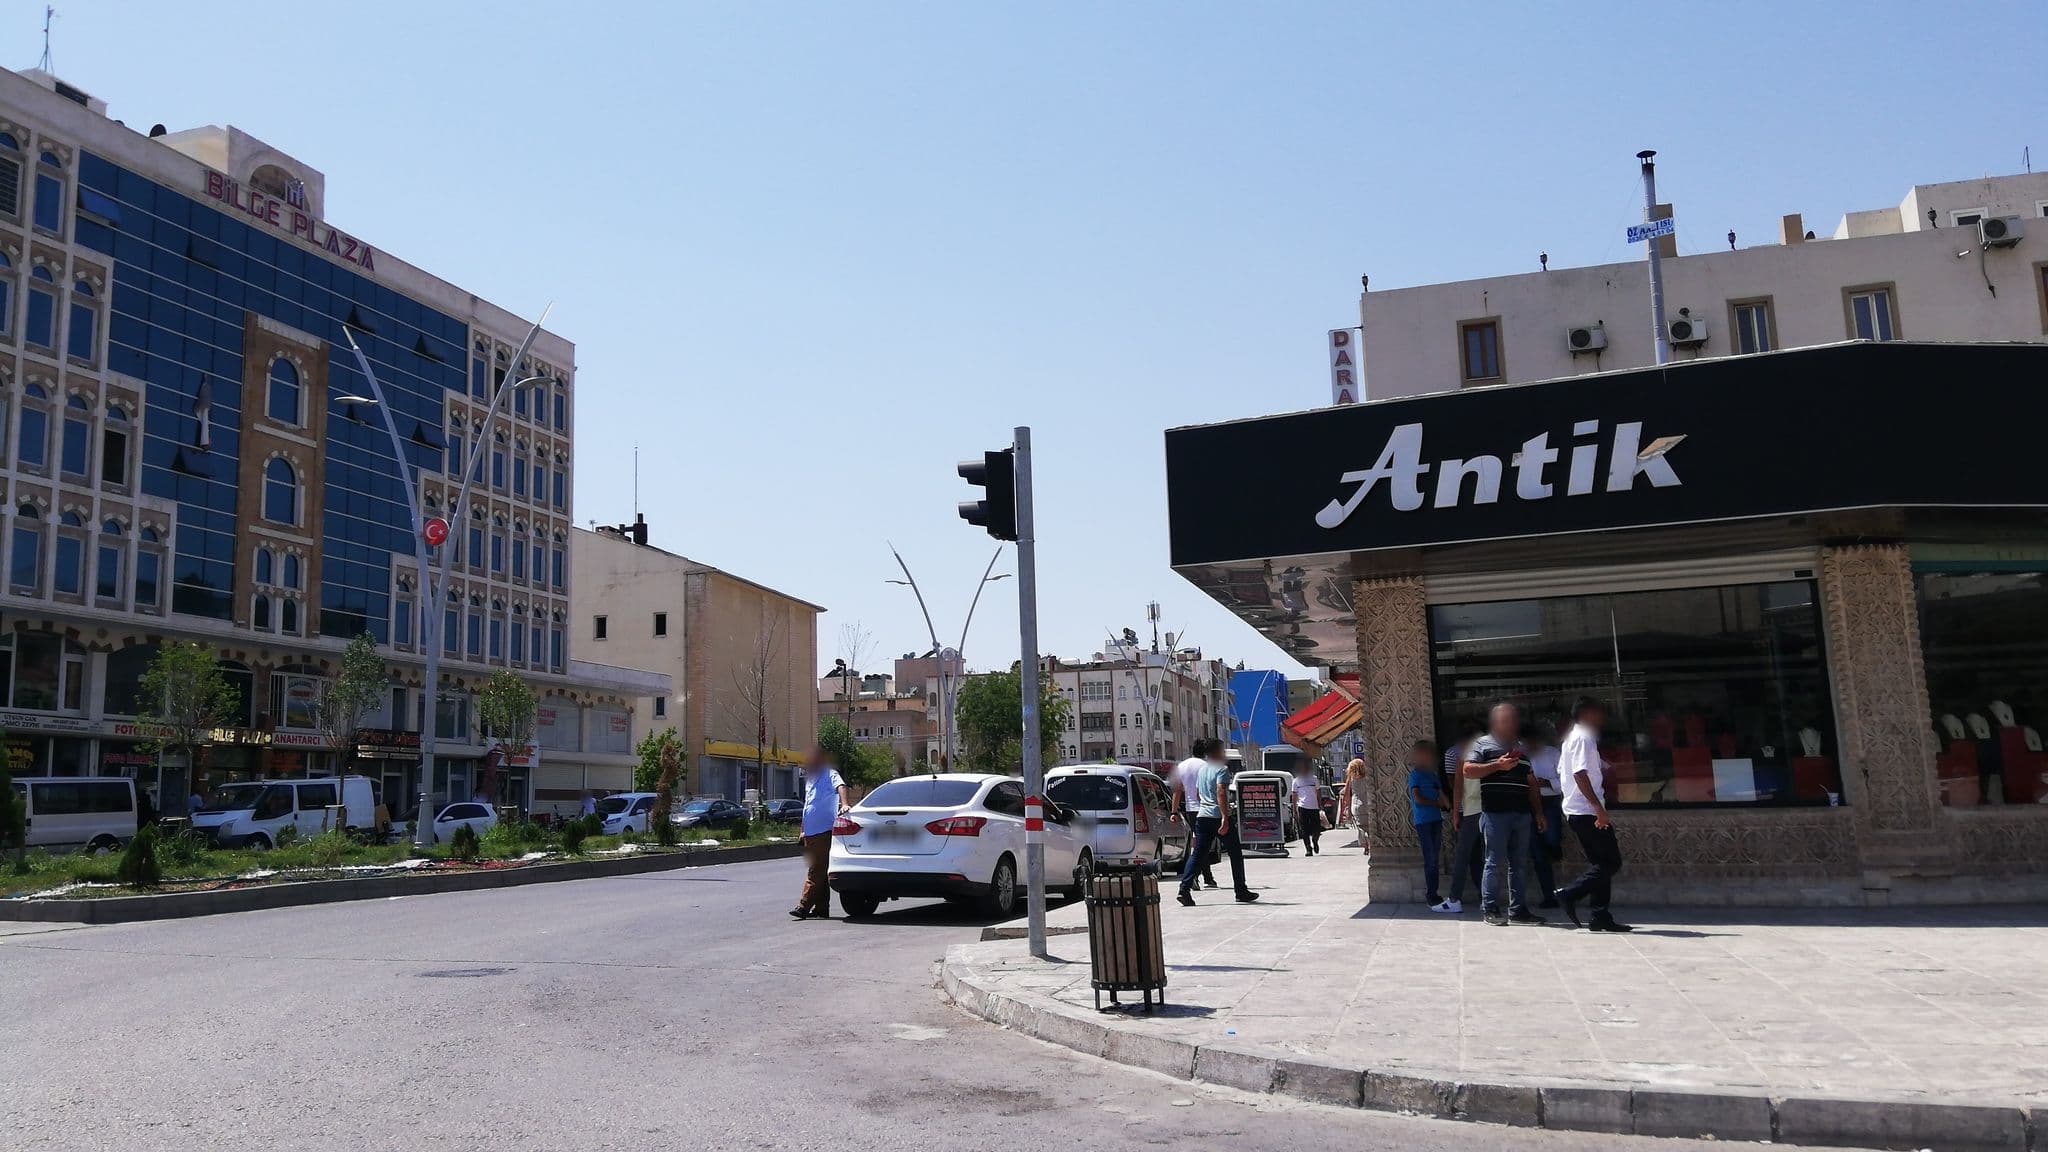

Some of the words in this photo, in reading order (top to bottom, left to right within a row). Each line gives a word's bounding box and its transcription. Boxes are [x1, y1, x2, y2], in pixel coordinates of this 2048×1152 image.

[293, 212, 375, 272] PLAZA
[1333, 330, 1355, 404] DARA
[1315, 419, 1689, 529] Antik
[274, 734, 321, 746] ANAHTARCI
